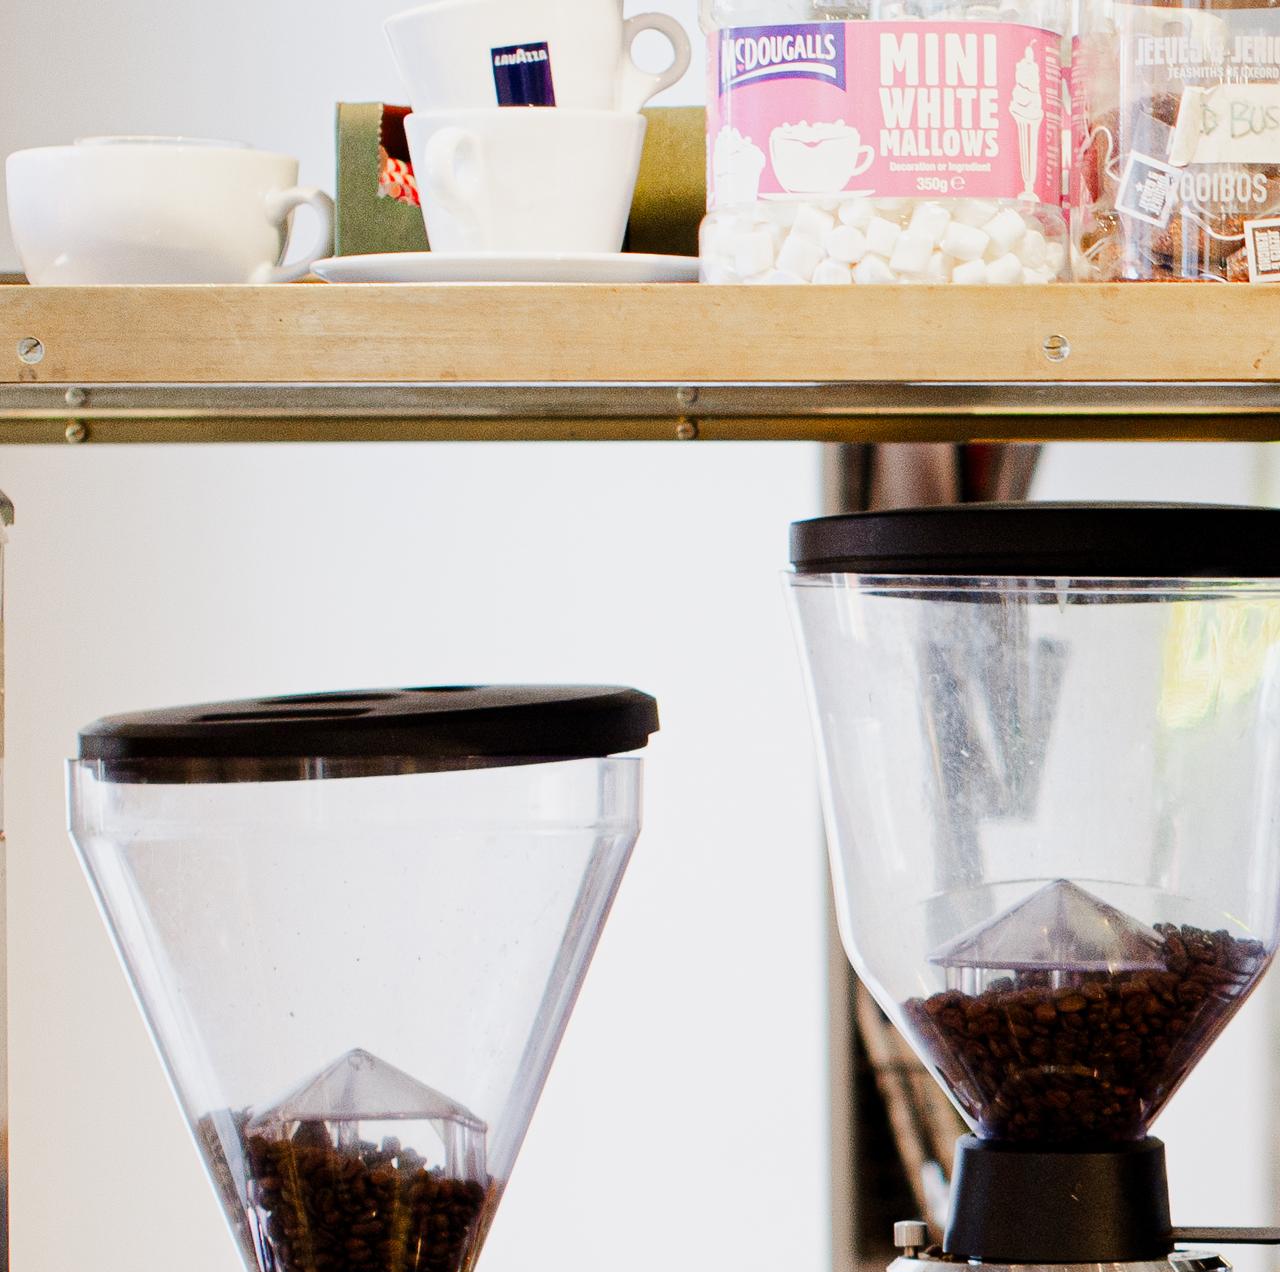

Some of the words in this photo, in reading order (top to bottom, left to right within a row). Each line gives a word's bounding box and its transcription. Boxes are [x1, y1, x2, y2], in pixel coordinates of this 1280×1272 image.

[494, 48, 547, 66] LAVAZZA
[880, 33, 997, 86] MINI
[879, 87, 999, 128] WHITE
[880, 129, 999, 157] MALLOWS
[889, 162, 935, 171] Decoration
[948, 162, 991, 173] Ingredient
[916, 177, 948, 192] 350g
